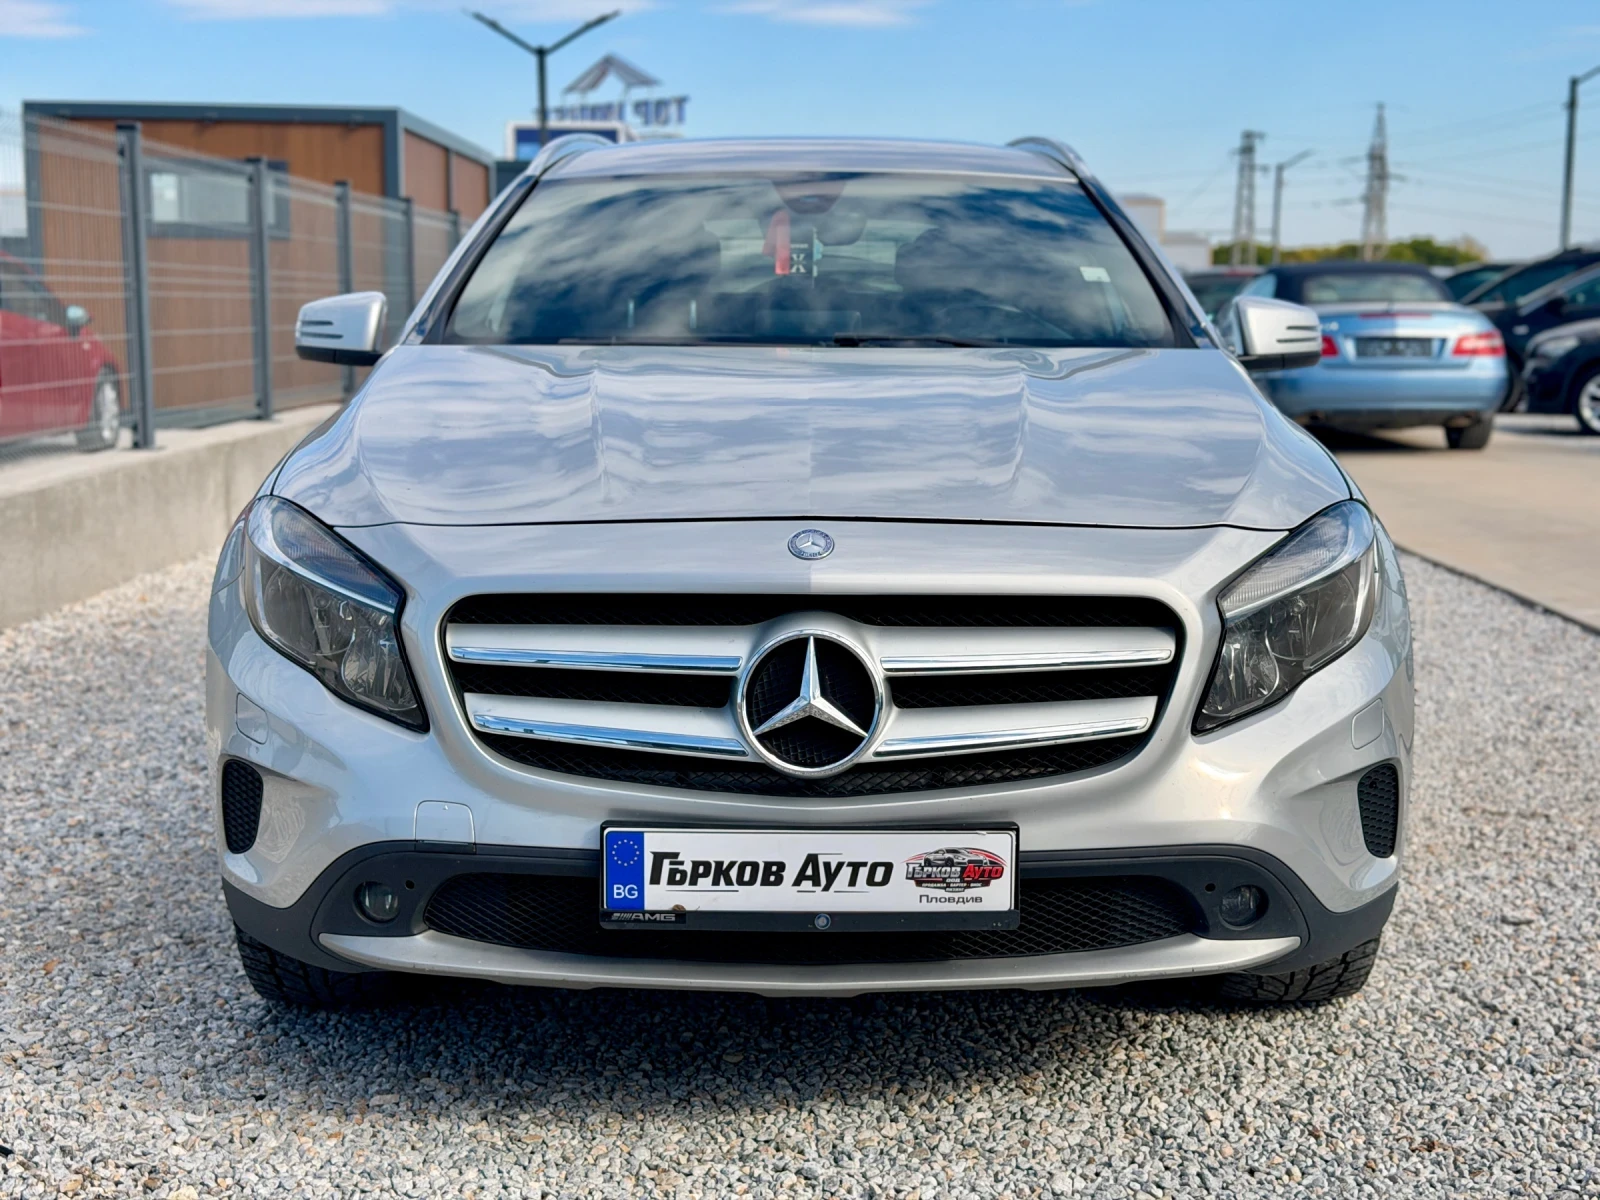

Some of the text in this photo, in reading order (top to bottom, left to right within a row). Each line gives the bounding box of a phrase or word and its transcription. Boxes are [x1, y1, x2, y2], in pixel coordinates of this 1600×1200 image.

[613, 884, 639, 899] BG
[919, 894, 983, 905] Пловдив
[631, 912, 676, 922] AMG
